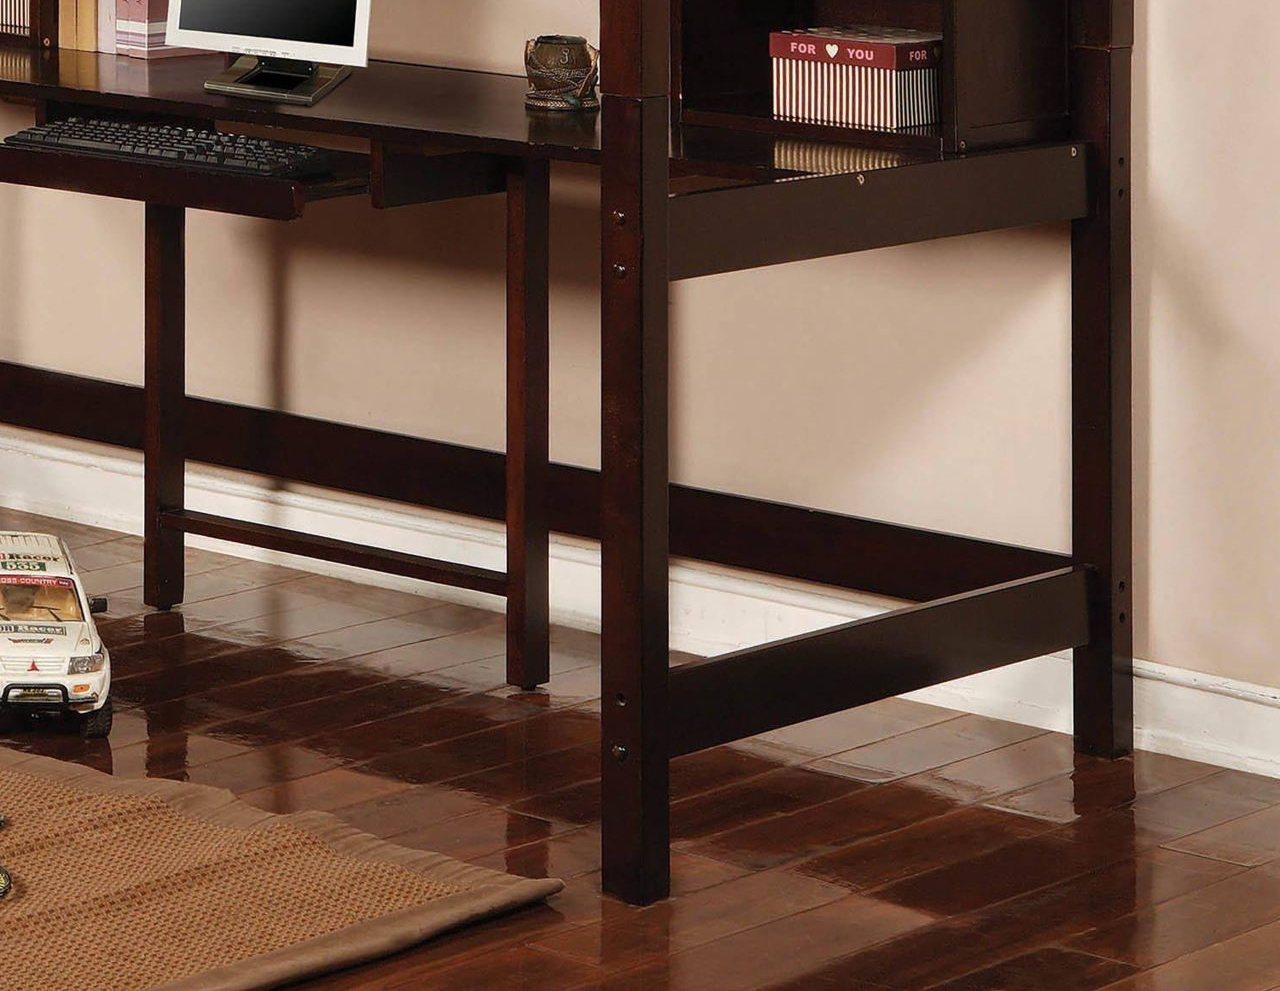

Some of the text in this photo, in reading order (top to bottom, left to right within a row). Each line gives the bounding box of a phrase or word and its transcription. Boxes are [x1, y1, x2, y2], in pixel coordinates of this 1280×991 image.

[790, 42, 873, 61] FOR YOU
[909, 50, 927, 61] FOR
